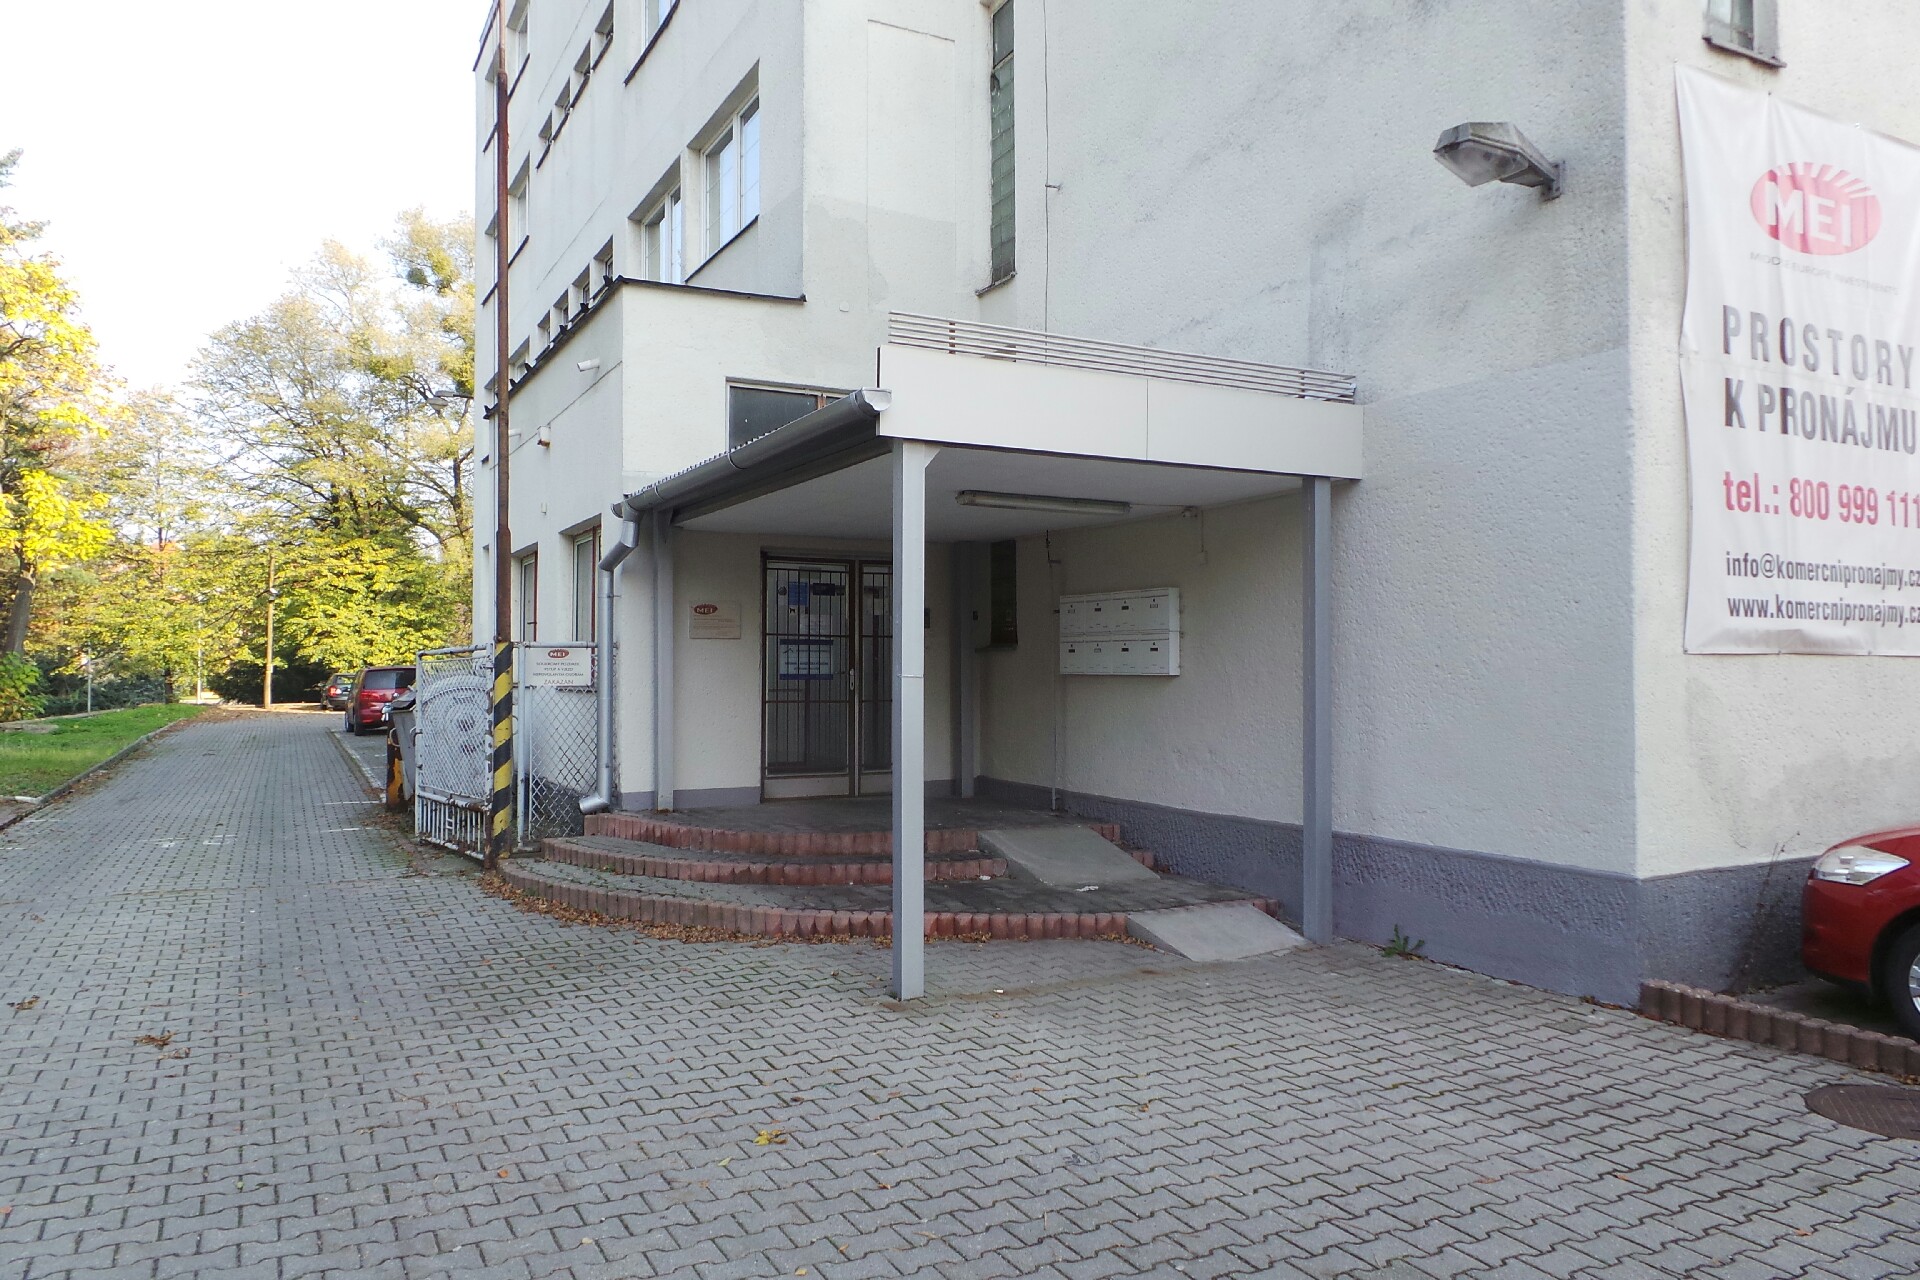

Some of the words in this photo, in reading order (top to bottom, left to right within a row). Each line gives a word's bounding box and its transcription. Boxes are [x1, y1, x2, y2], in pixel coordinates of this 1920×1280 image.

[1765, 181, 1851, 248] MEI
[1723, 305, 1914, 389] PROSTORY
[1725, 378, 1745, 428] K
[1758, 383, 1916, 455] PRONÁJMU
[1723, 471, 1779, 515] tel.:
[1790, 477, 1829, 520] 800
[1838, 484, 1878, 525] 999
[1886, 490, 1920, 529] 111
[1726, 551, 1920, 591] info@komercnipronajmy.cz
[1728, 594, 1920, 628] www.komercnipronajmy.cz
